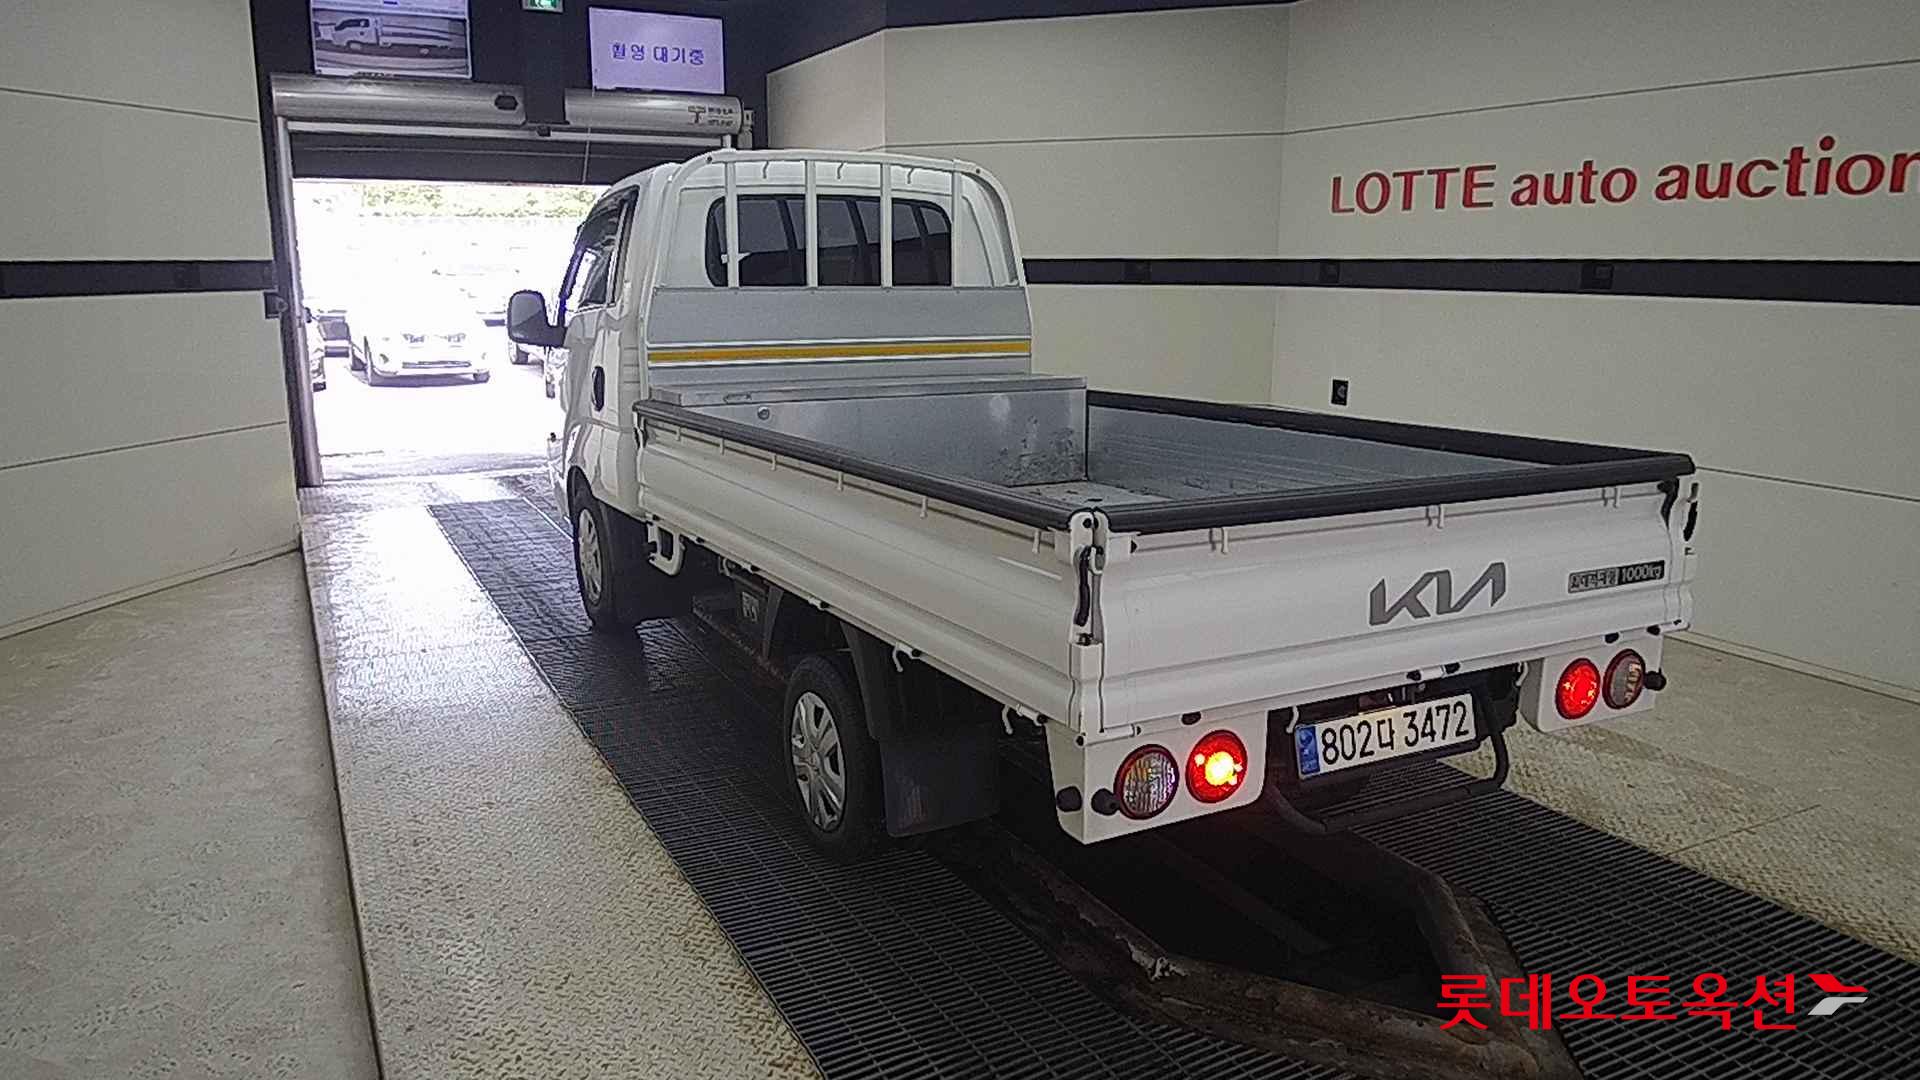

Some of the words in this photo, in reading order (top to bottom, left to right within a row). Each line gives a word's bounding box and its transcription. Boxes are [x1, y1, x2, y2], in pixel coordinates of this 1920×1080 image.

[1331, 164, 1497, 214] LOTTE
[1510, 160, 1638, 207] auto
[1369, 562, 1506, 626] KIA
[1321, 717, 1395, 765] 802다
[1402, 700, 1470, 747] 3472
